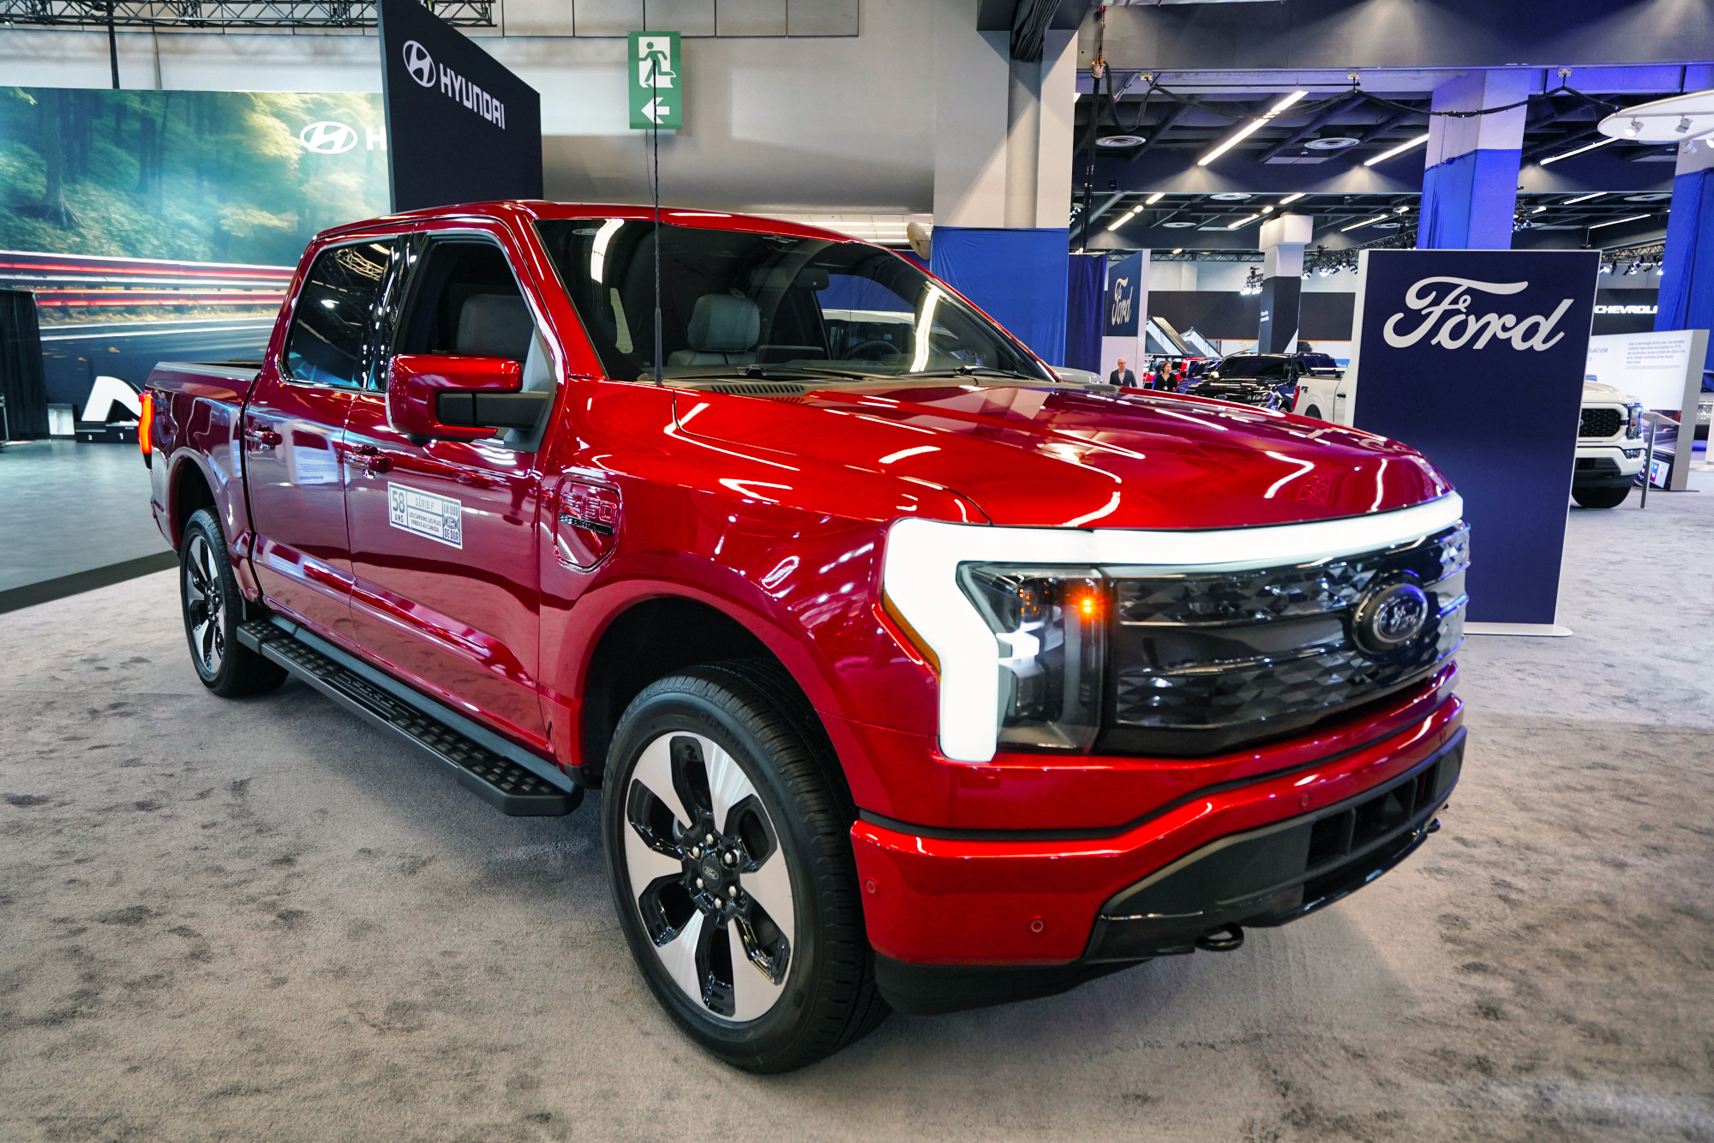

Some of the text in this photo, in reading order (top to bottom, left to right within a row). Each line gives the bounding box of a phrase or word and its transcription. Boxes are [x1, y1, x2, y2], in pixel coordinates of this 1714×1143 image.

[439, 63, 506, 130] HYUNDAI
[1111, 276, 1134, 326] Ford
[1383, 277, 1574, 352] Ford
[392, 490, 405, 514] 58
[394, 513, 404, 523] ANS
